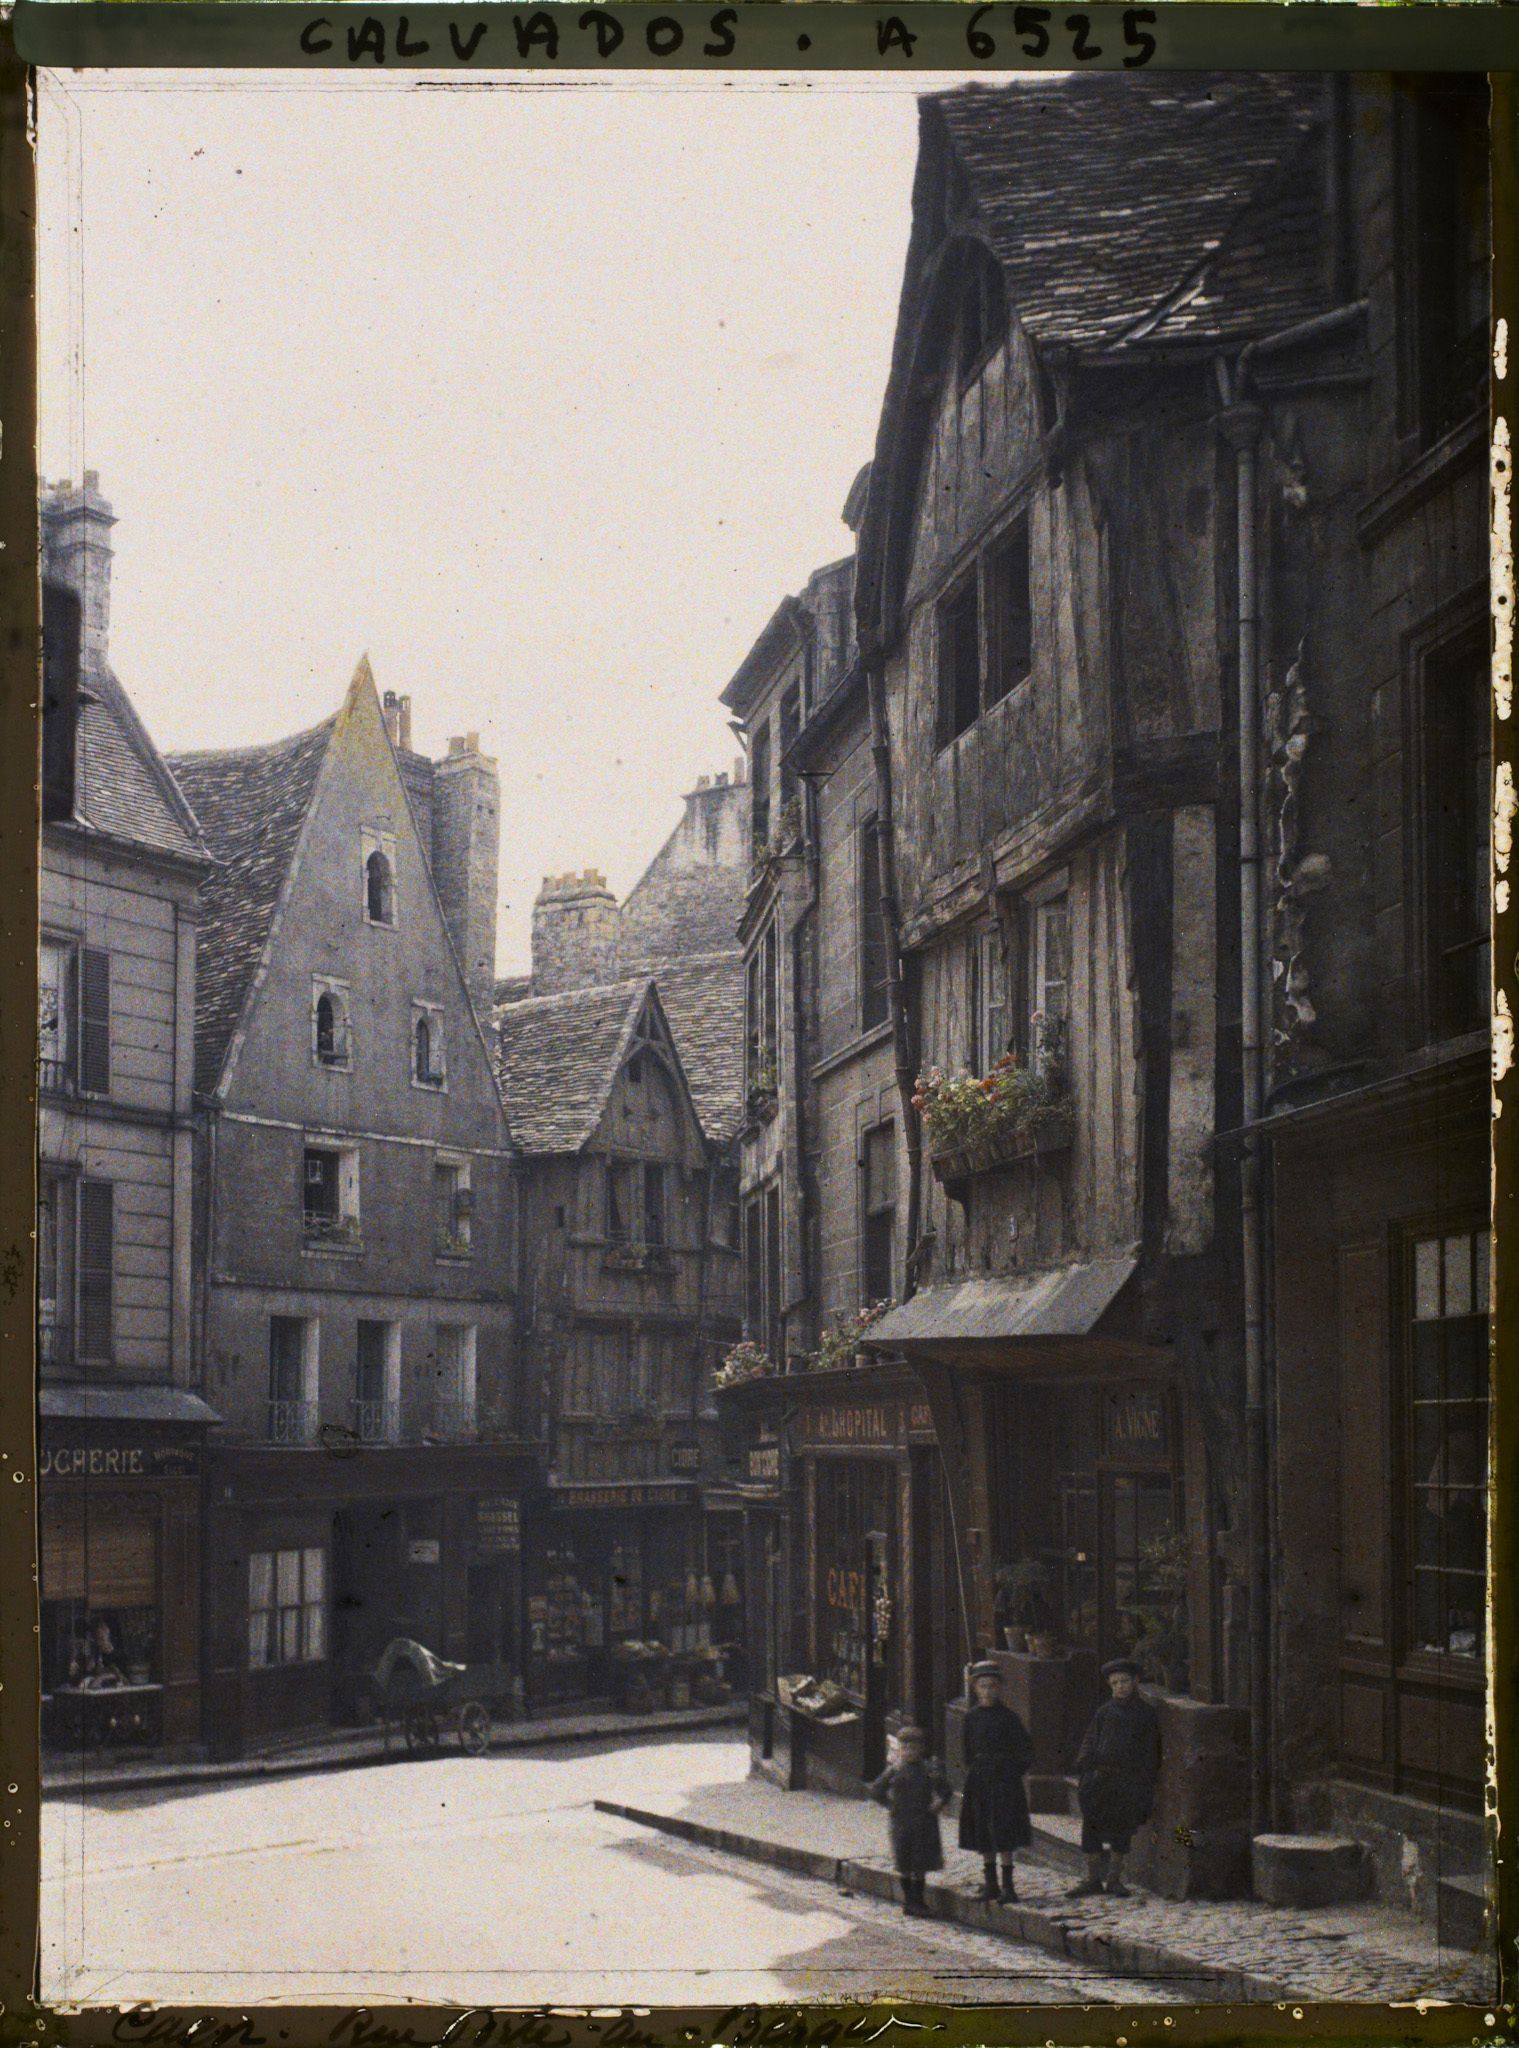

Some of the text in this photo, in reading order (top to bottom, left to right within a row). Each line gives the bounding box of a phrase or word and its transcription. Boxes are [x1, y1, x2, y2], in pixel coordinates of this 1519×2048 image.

[300, 5, 1157, 68] CALVADOS A 6525
